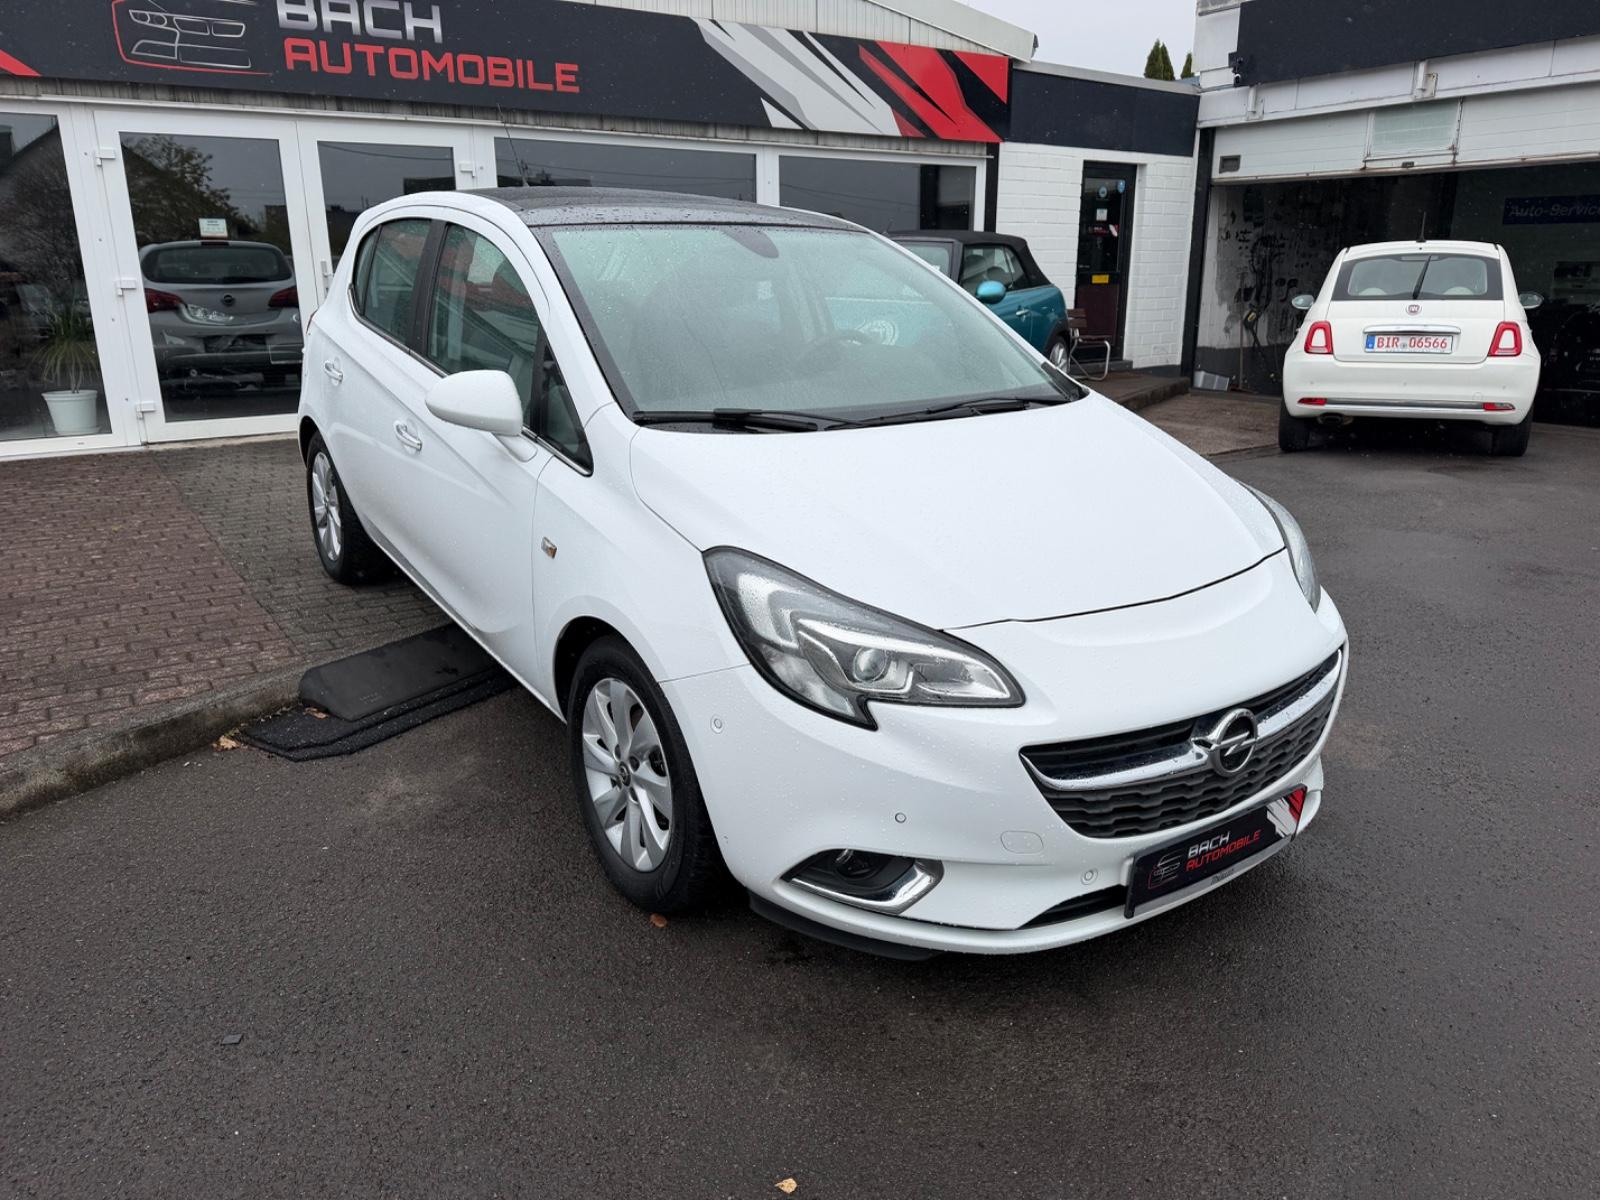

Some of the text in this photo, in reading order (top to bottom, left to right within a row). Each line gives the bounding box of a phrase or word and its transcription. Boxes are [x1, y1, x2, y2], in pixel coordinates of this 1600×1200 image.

[277, 0, 443, 43] BACH
[283, 37, 580, 93] AUTOMOBILE
[1377, 337, 1447, 349] BIR 06566
[1186, 830, 1261, 871] AUTOMOBILE
[1188, 832, 1230, 858] BACH
